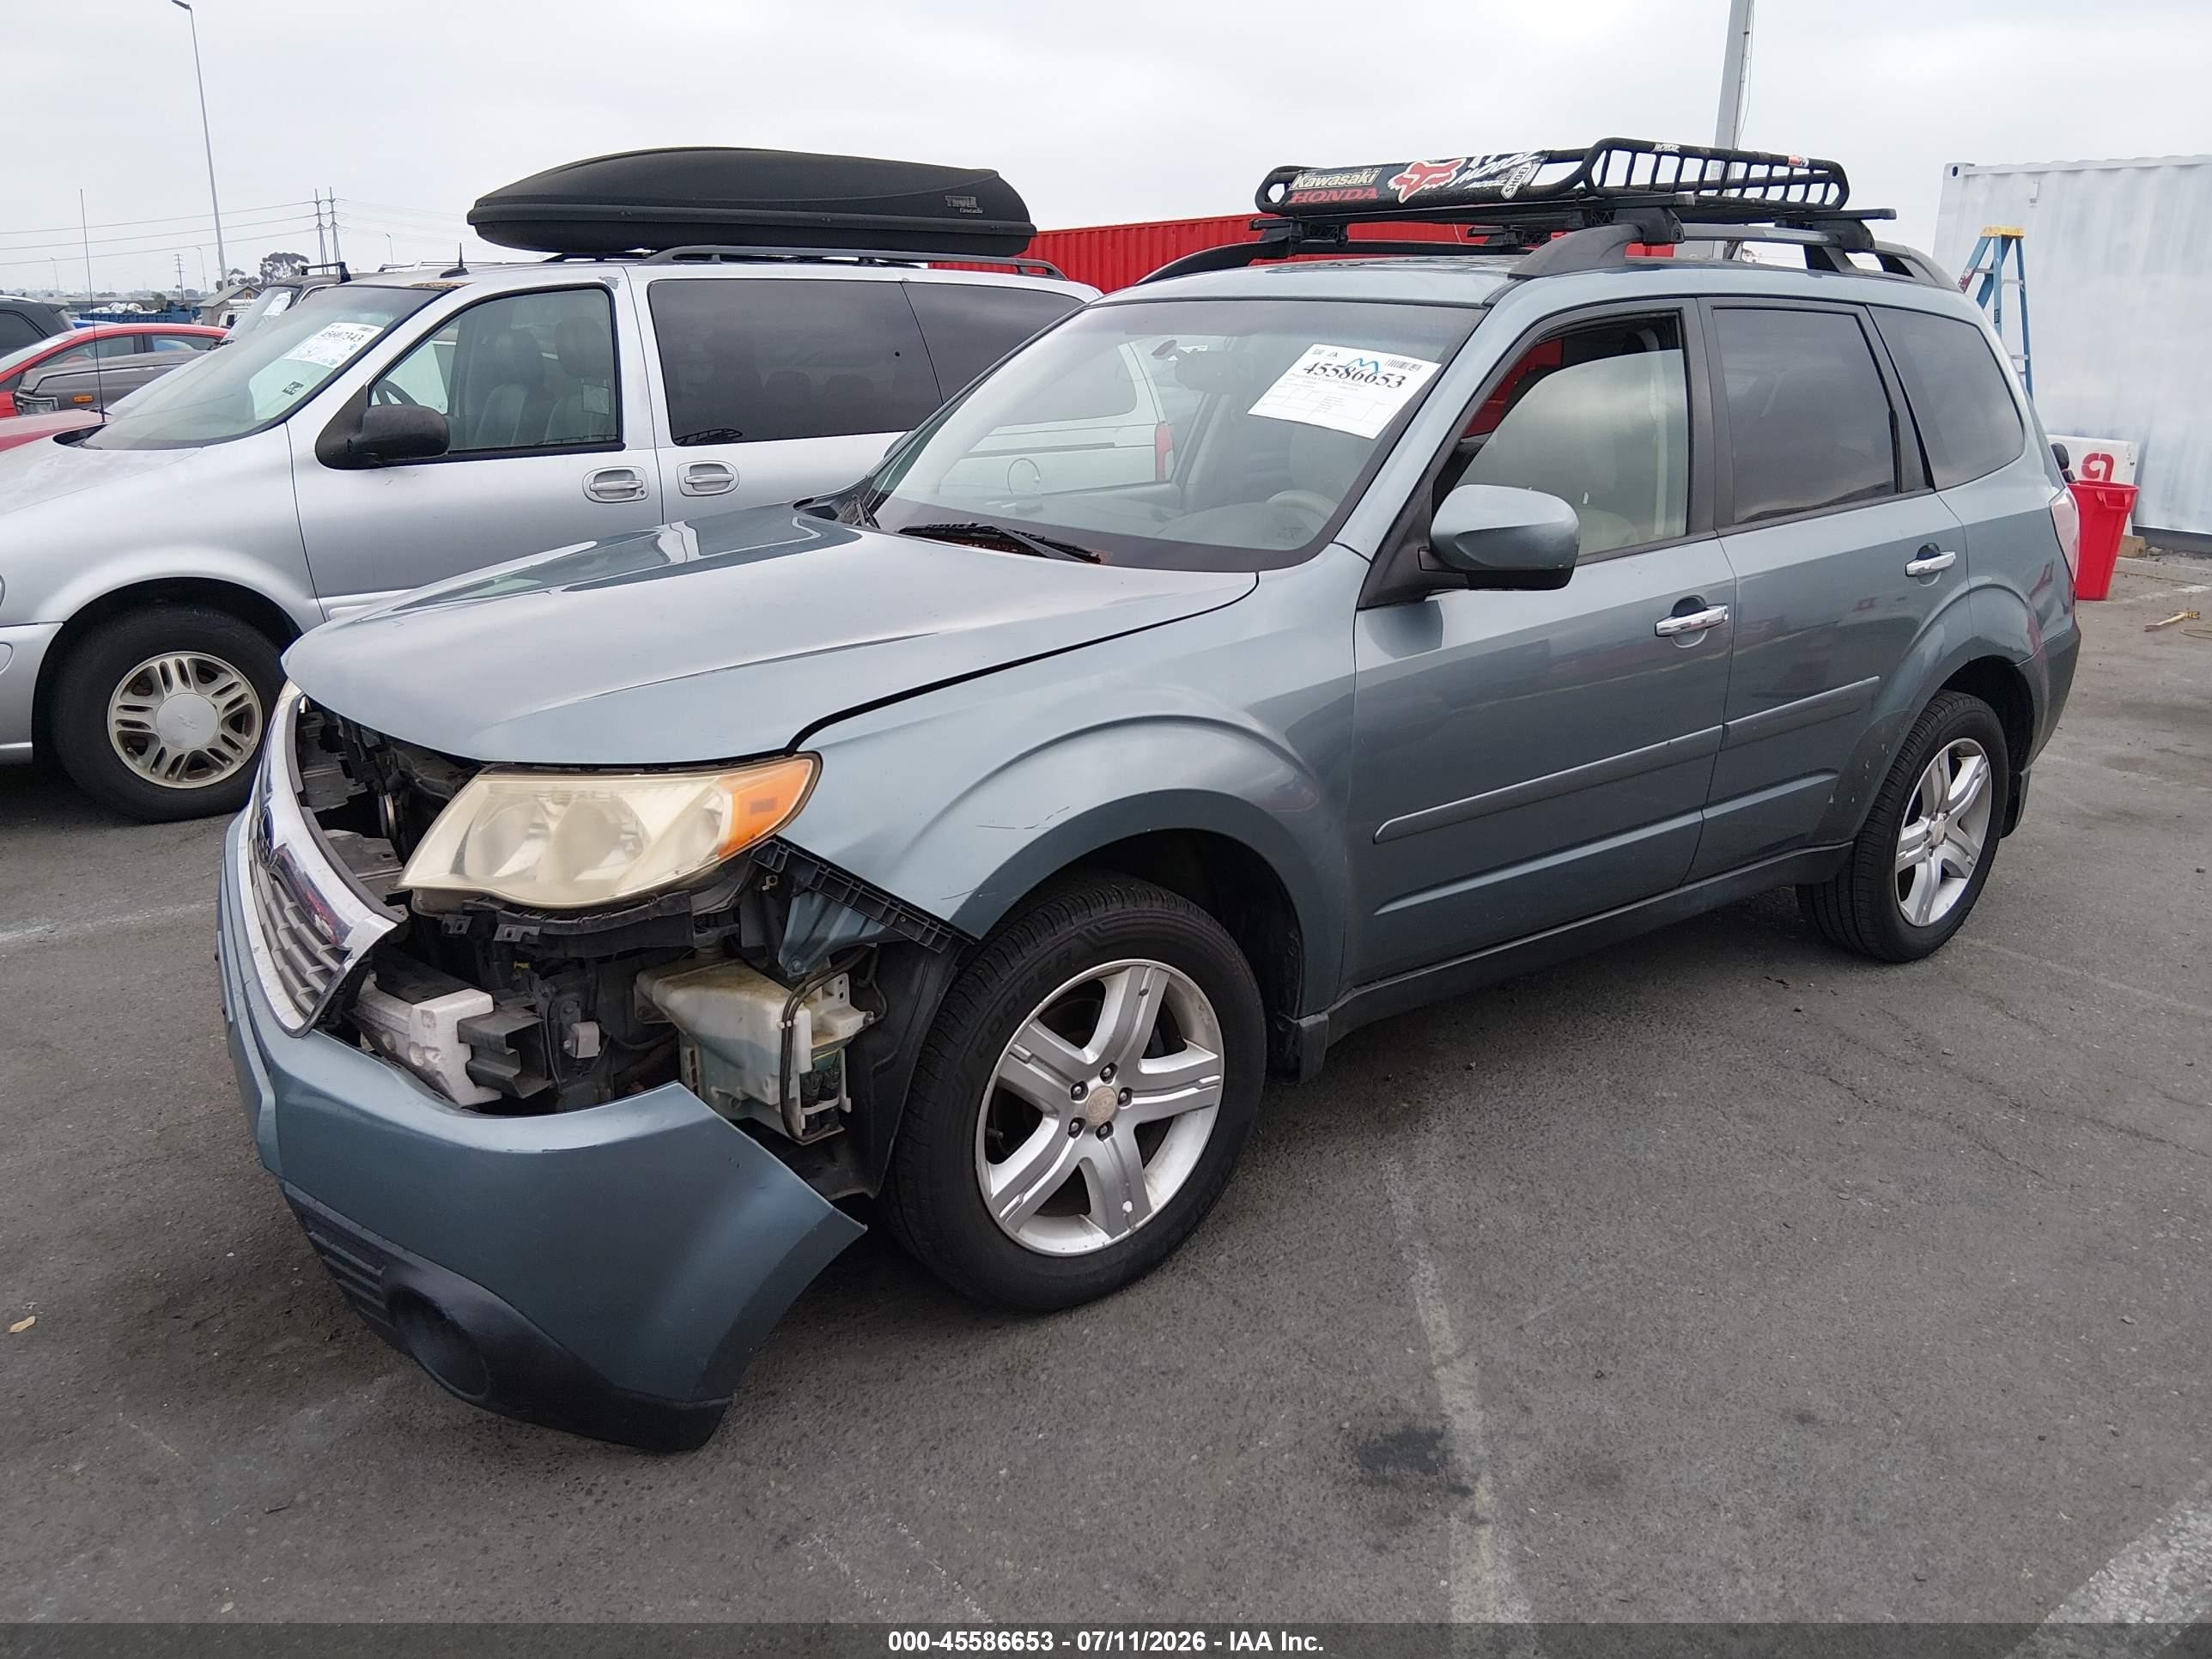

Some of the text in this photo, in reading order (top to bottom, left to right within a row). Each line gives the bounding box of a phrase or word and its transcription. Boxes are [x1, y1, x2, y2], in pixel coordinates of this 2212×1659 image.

[1291, 170, 1381, 189] Kawasaki
[1505, 167, 1530, 193] SHOEI
[1290, 187, 1379, 204] HONDA
[1303, 362, 1407, 389] 45586653
